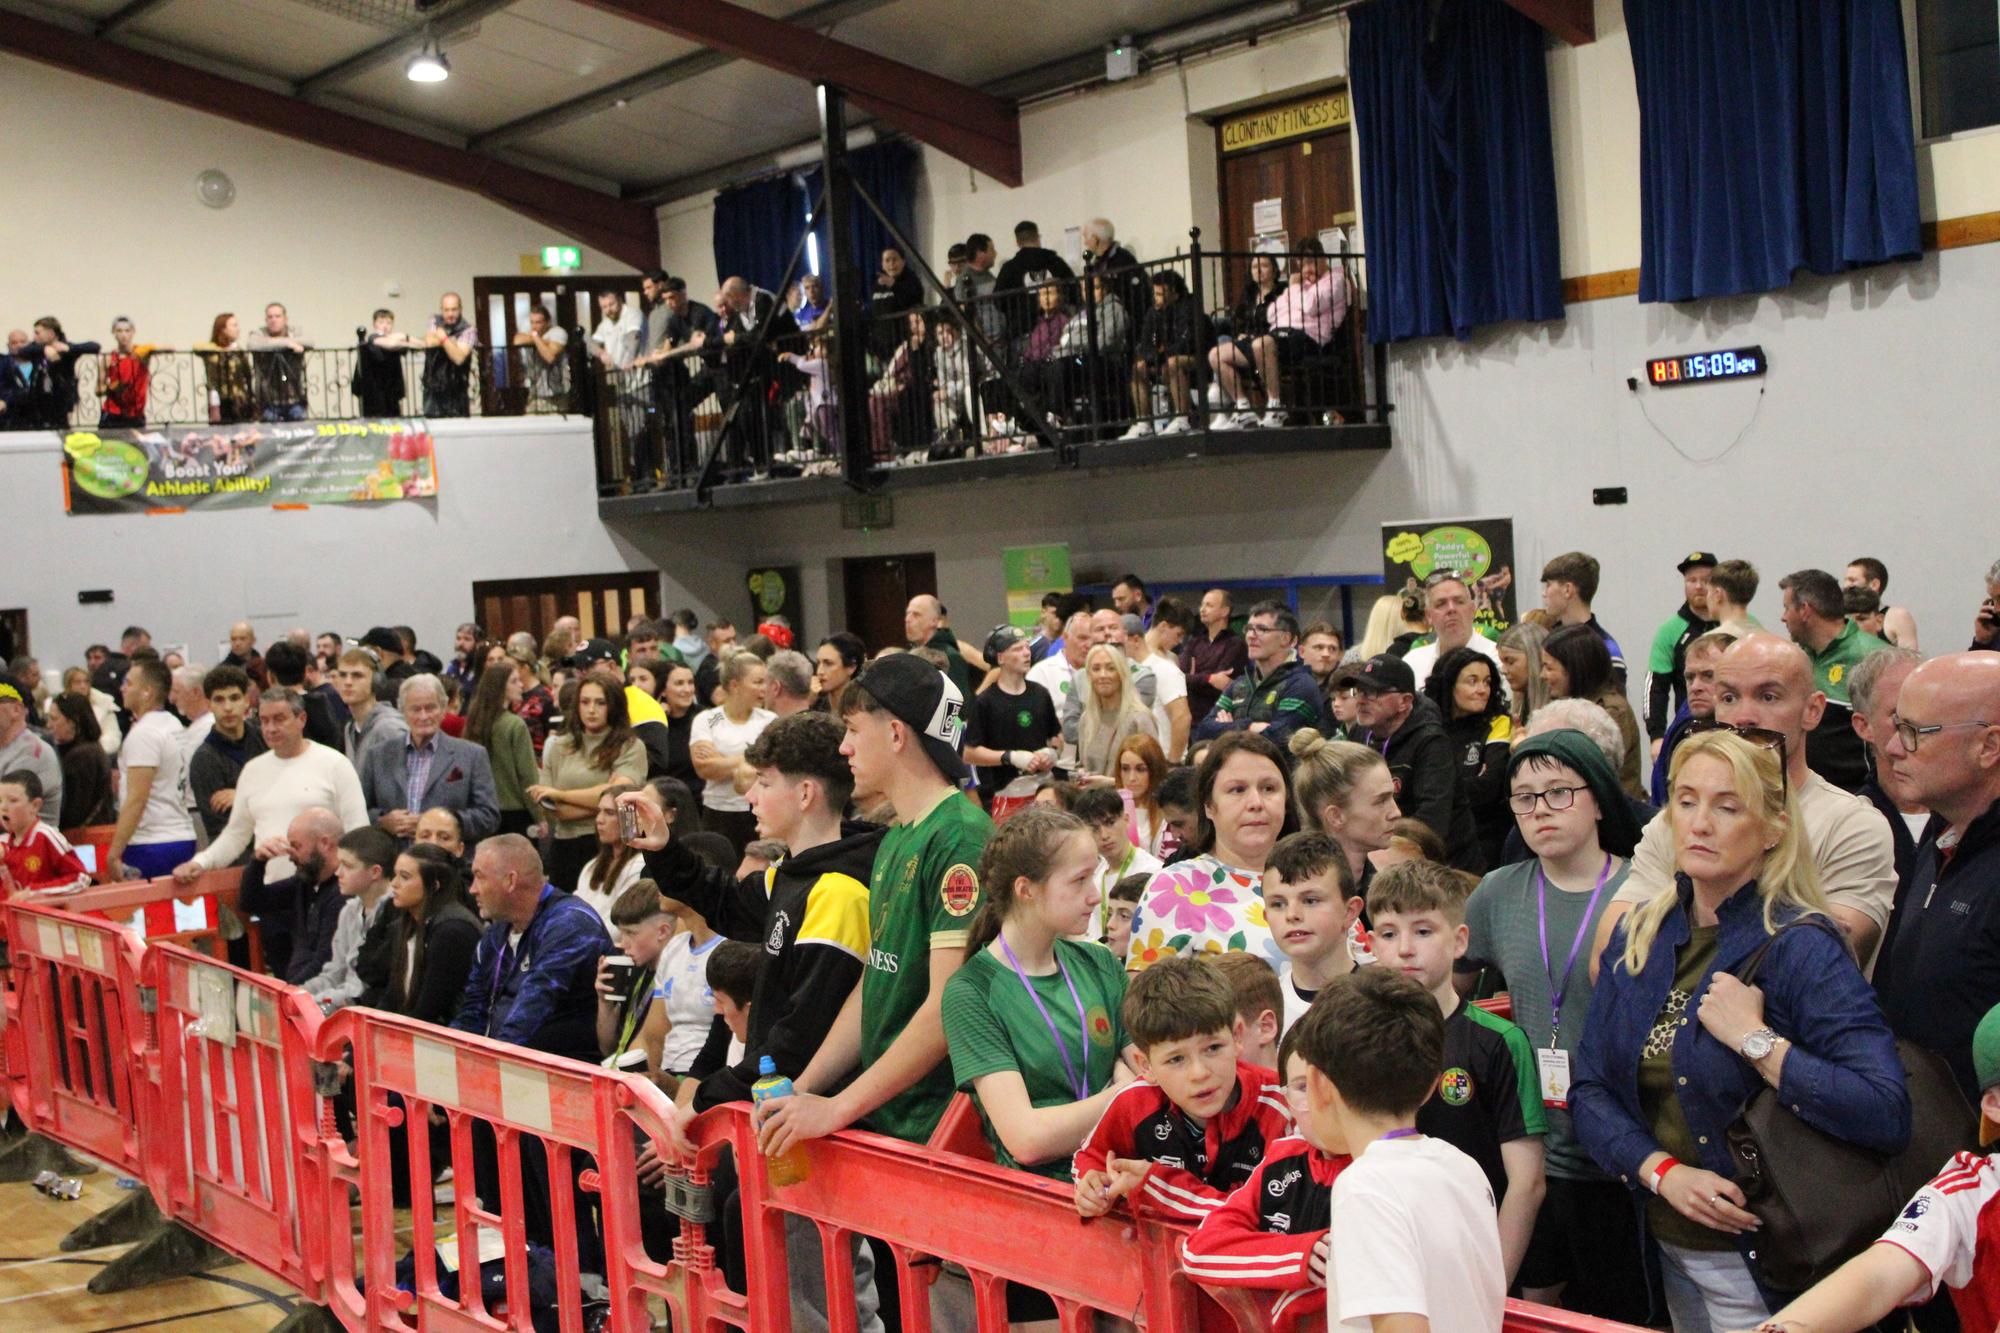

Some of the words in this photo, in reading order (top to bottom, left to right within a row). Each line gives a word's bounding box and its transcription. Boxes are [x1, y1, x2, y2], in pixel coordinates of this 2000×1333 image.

[1225, 113, 1280, 145] CLONMANY
[1283, 102, 1329, 132] FITNESS
[337, 423, 368, 438] Day
[165, 462, 210, 479] Boost
[213, 461, 247, 476] Your
[146, 480, 209, 497] Athletic
[213, 475, 271, 493] Ability!
[1434, 551, 1470, 560] Powerful
[1435, 560, 1469, 569] BOTTLE
